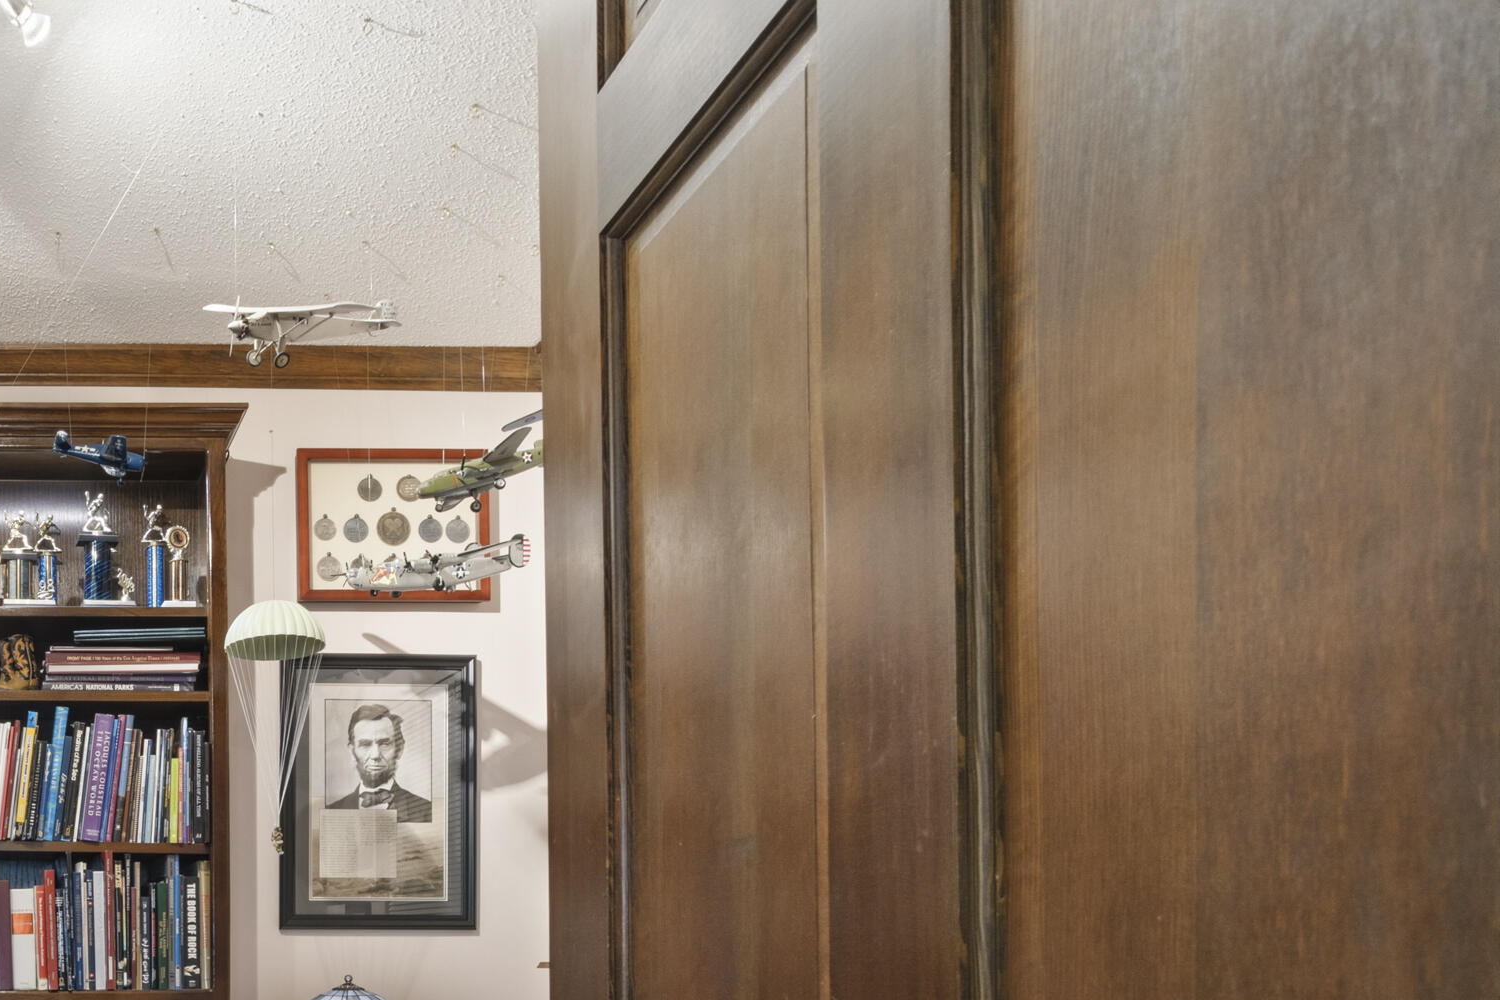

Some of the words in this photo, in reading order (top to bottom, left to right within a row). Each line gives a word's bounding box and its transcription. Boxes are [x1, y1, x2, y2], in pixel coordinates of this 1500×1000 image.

[76, 730, 84, 752] Realms
[96, 730, 104, 747] THE
[100, 730, 111, 768] JACQUES
[91, 750, 102, 782] OCEAN
[87, 785, 98, 817] WORLD
[95, 771, 106, 817] COUSTEAU
[187, 883, 197, 898] THE
[187, 900, 197, 923] BOOK
[187, 925, 197, 935] OF
[187, 936, 197, 960] ROCK
